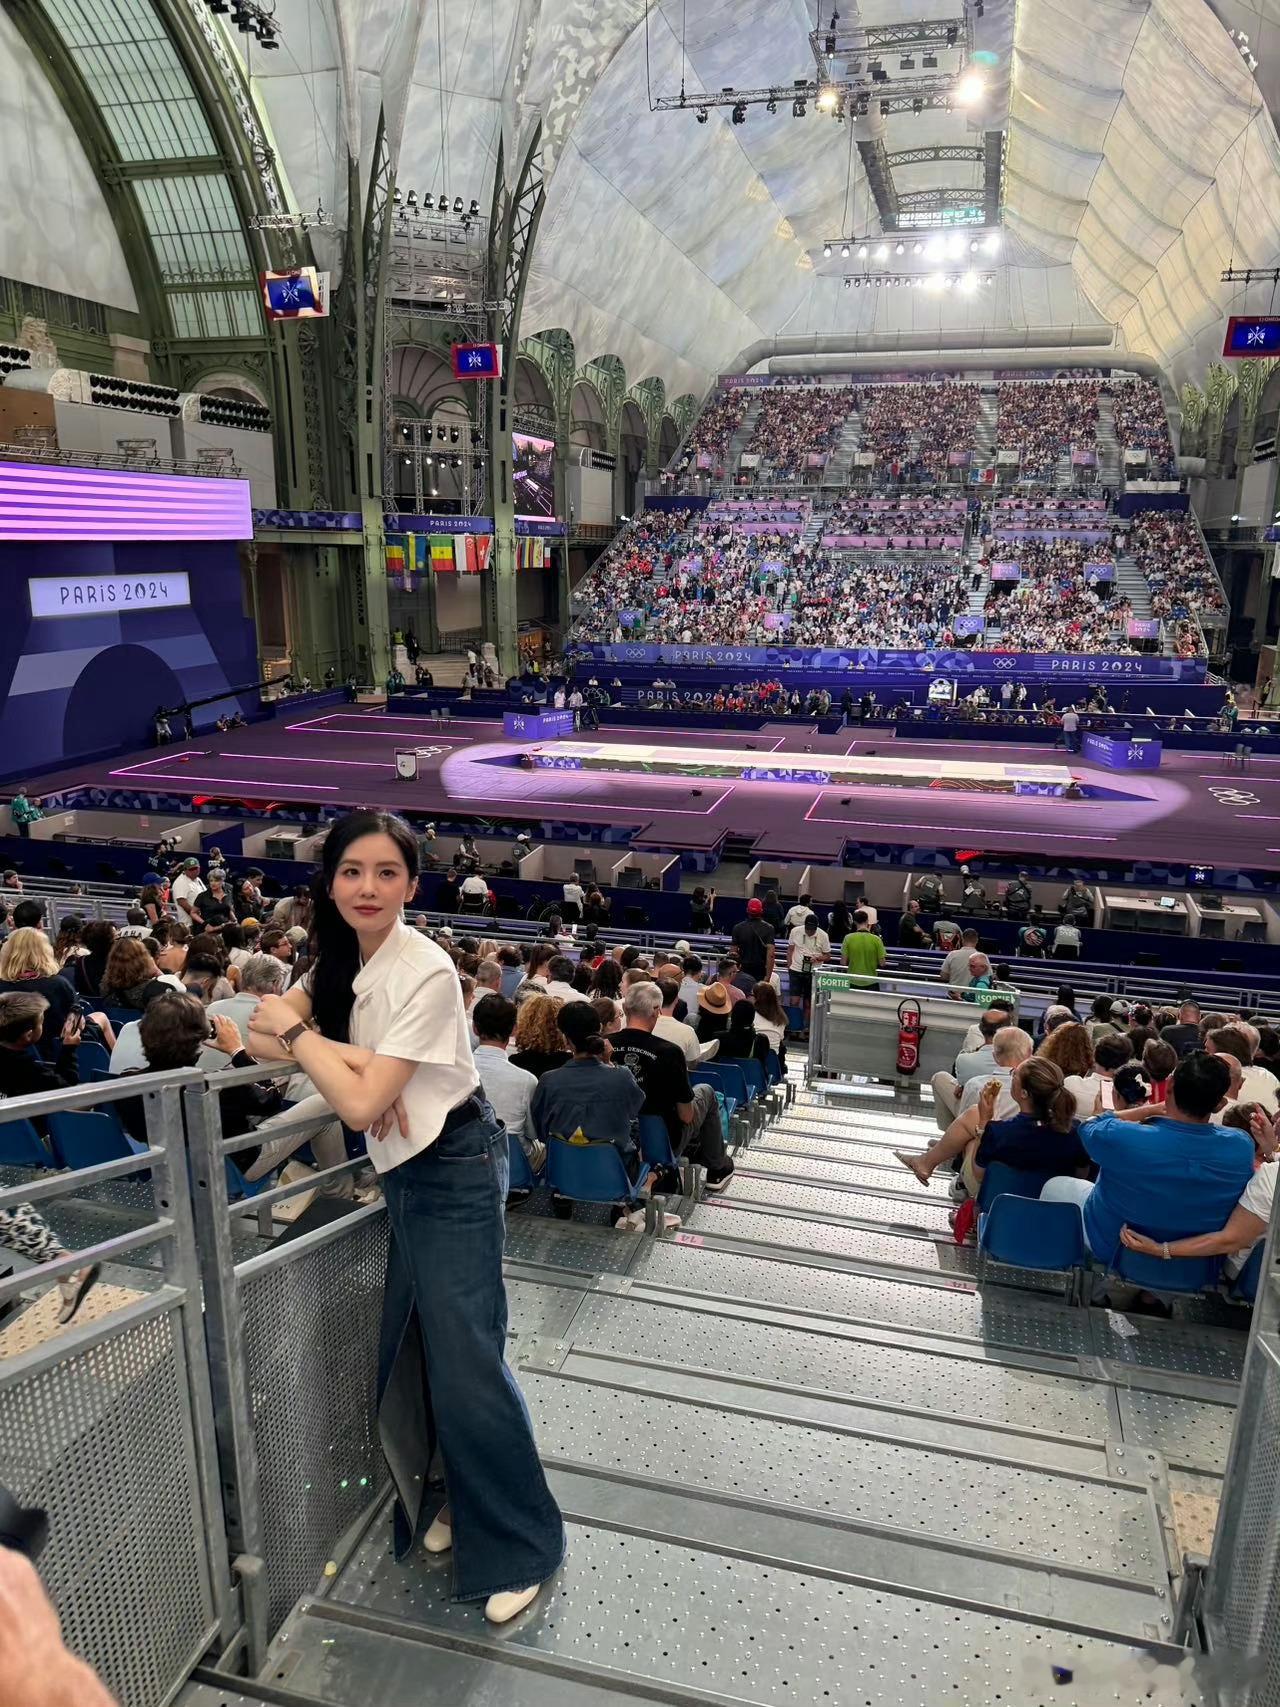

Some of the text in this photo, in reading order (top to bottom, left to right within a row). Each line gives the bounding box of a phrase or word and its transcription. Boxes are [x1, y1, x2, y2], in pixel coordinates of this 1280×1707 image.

[123, 581, 169, 601] 2024
[717, 651, 752, 663] 2024
[1101, 660, 1143, 672] 2024
[684, 691, 712, 703] 202
[822, 976, 849, 988] SORTIE
